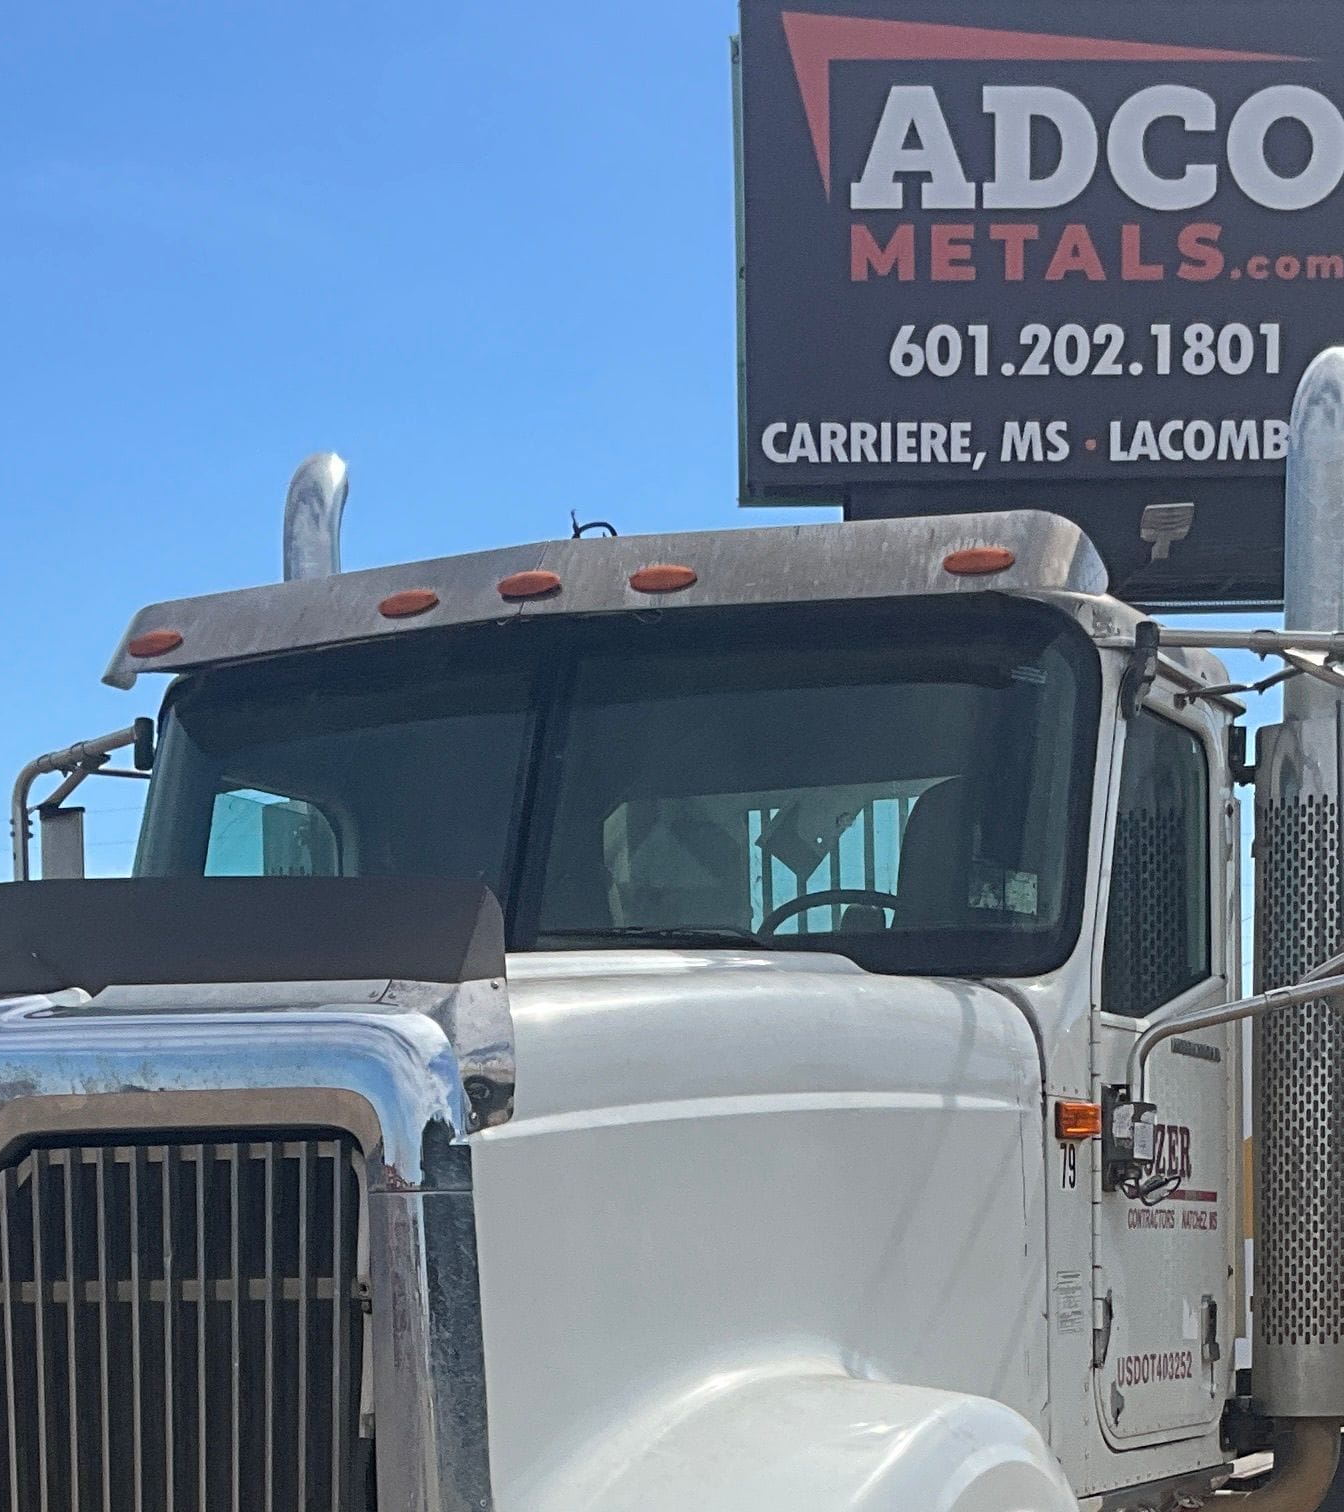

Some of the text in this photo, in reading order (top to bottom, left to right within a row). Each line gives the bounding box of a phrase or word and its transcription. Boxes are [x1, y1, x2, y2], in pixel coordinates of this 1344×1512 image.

[888, 322, 1282, 378] 601.202.1801
[761, 421, 988, 470] CARRIERE,
[999, 419, 1070, 462] MS
[1060, 1142, 1077, 1189] 79
